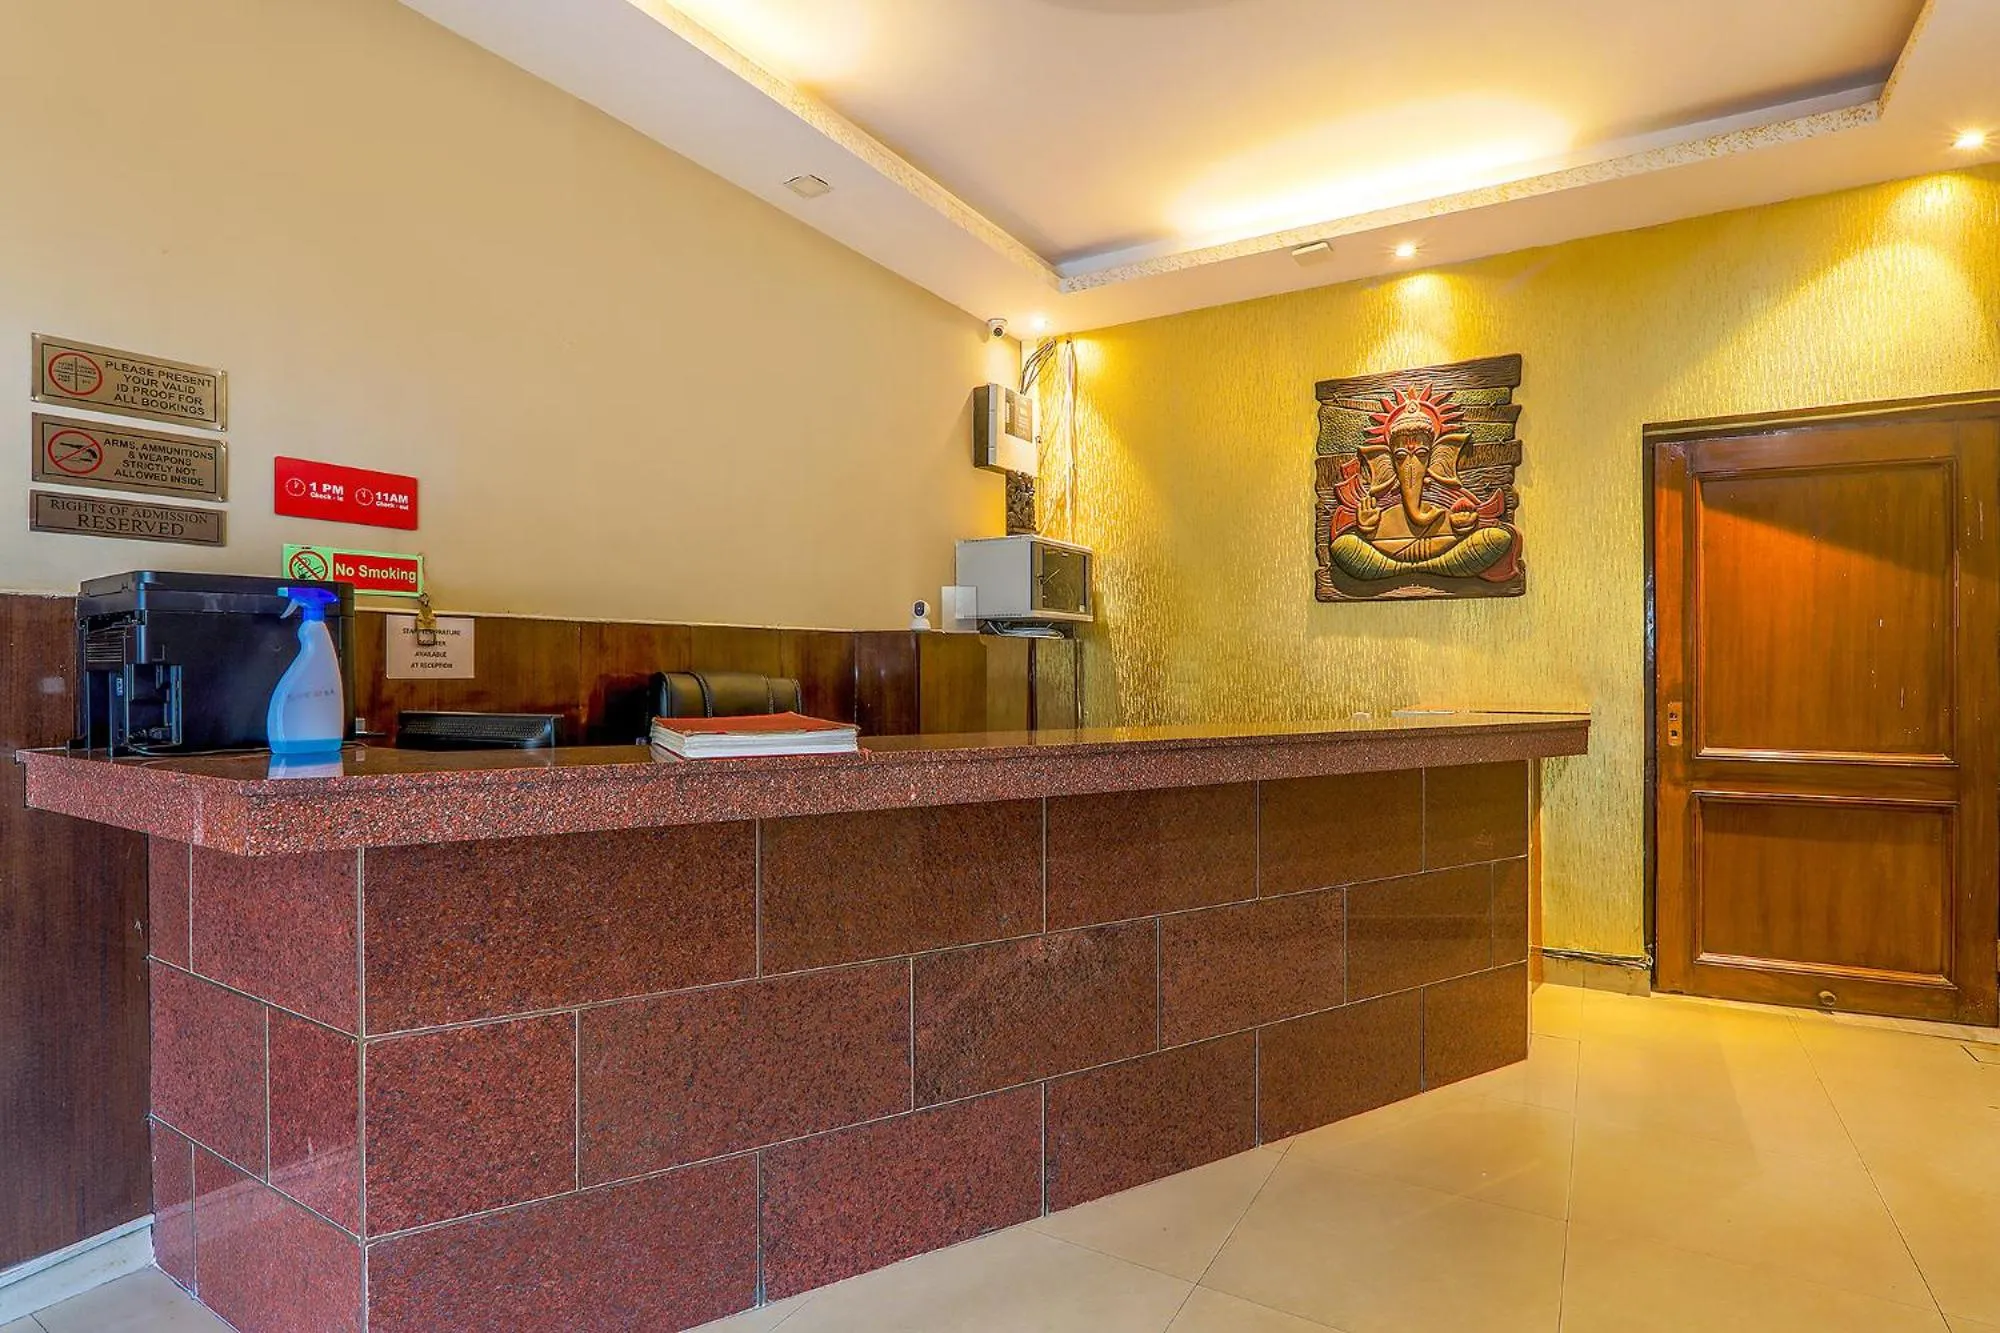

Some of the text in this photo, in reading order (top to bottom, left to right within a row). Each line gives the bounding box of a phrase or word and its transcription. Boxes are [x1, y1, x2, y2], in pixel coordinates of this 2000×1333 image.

[105, 360, 154, 377] PLEASE
[158, 371, 212, 388] PRESENT
[116, 383, 203, 406] ID PROOF FOR
[124, 374, 196, 395] YOUR VALID
[114, 393, 205, 415] ALL BOOKINGS
[103, 438, 214, 461] ARMS, AMMUNITIONS
[128, 451, 192, 466] & WEAPONS
[114, 469, 205, 487] ALLOWED INSIDE
[122, 460, 198, 477] STRICTLY NOT
[309, 482, 344, 495] 1 PM
[310, 491, 331, 500] Check
[375, 491, 409, 504] 11AM
[50, 499, 209, 524] RIGHTS OF ADMISSION
[376, 501, 395, 509] Check
[77, 514, 185, 536] RESERVED
[335, 563, 416, 583] No Smoking
